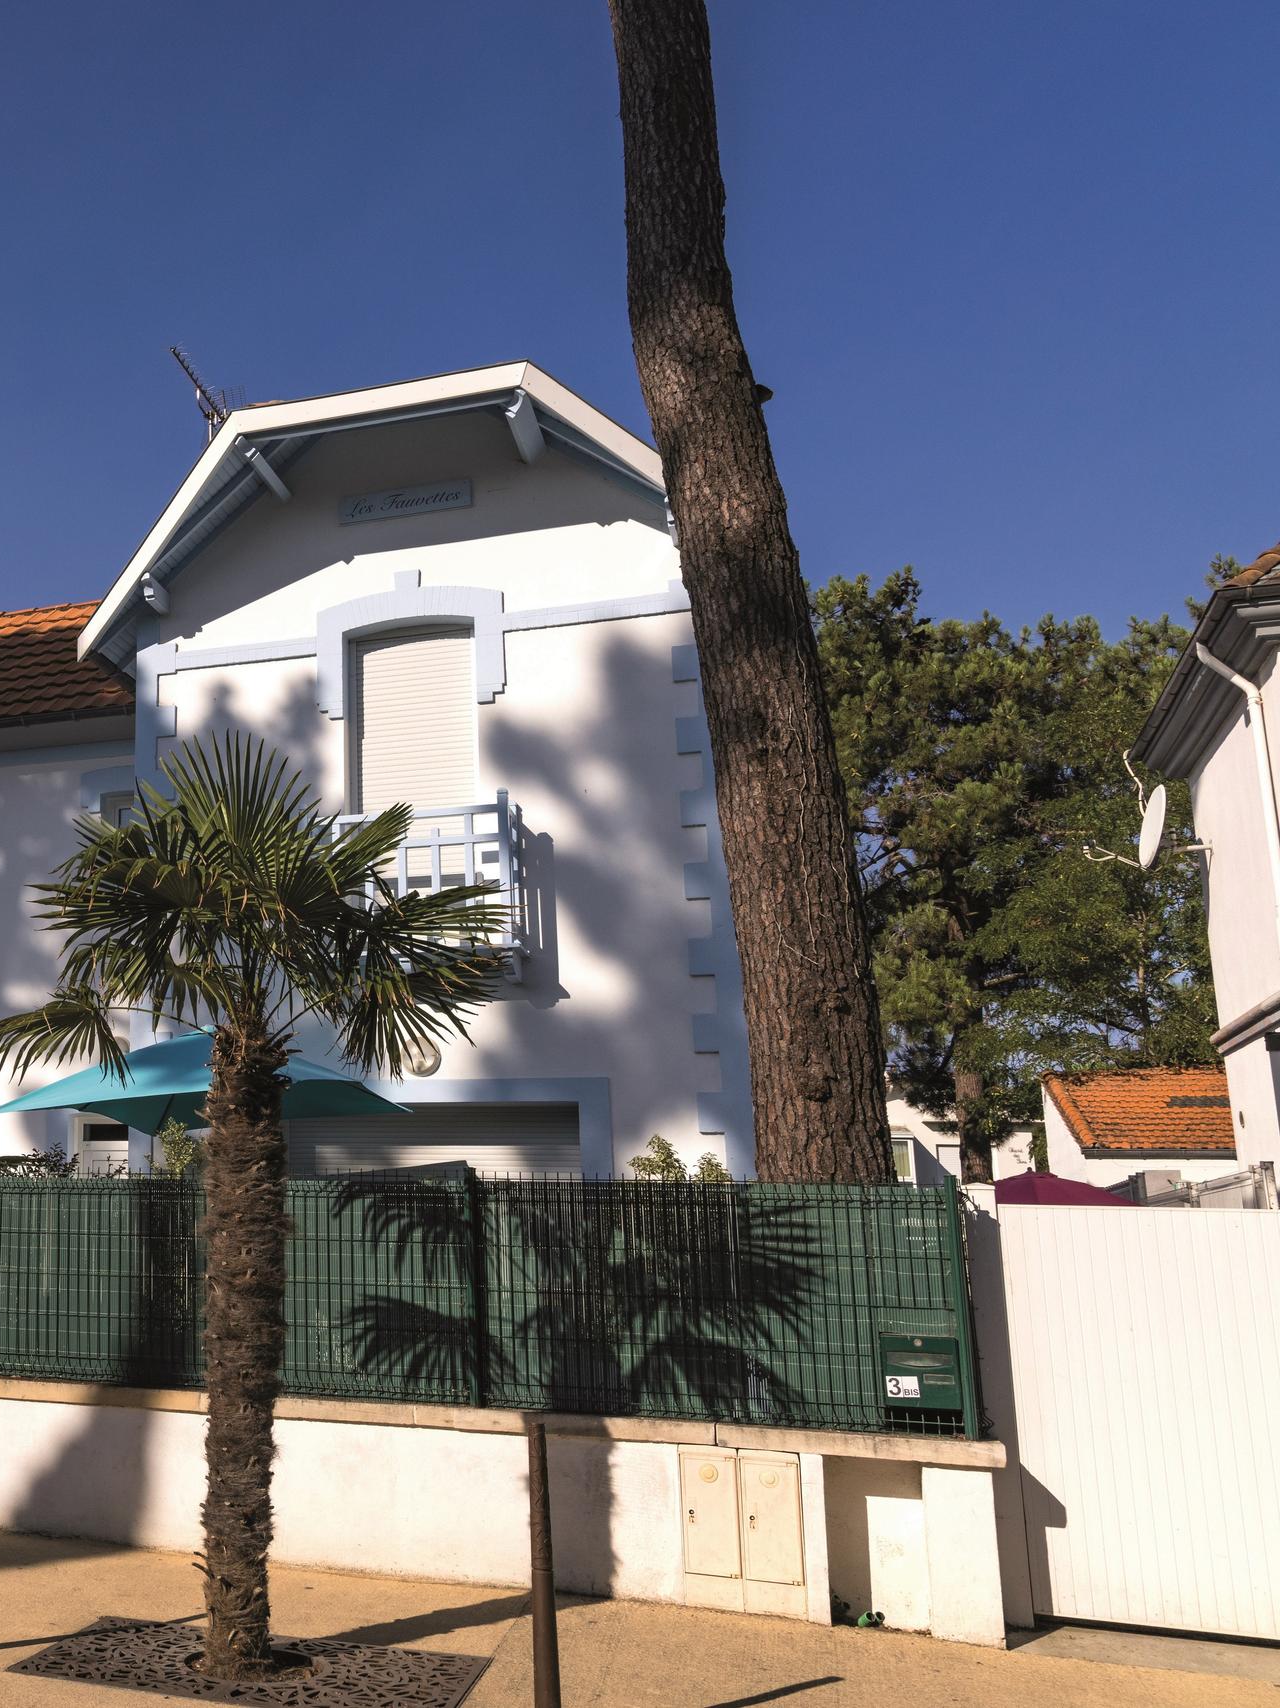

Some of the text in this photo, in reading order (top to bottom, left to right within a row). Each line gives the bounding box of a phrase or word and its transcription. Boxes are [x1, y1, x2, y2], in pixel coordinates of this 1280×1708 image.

[345, 490, 462, 518] Les Fauvettes
[888, 1377, 919, 1396] 3 BIS
